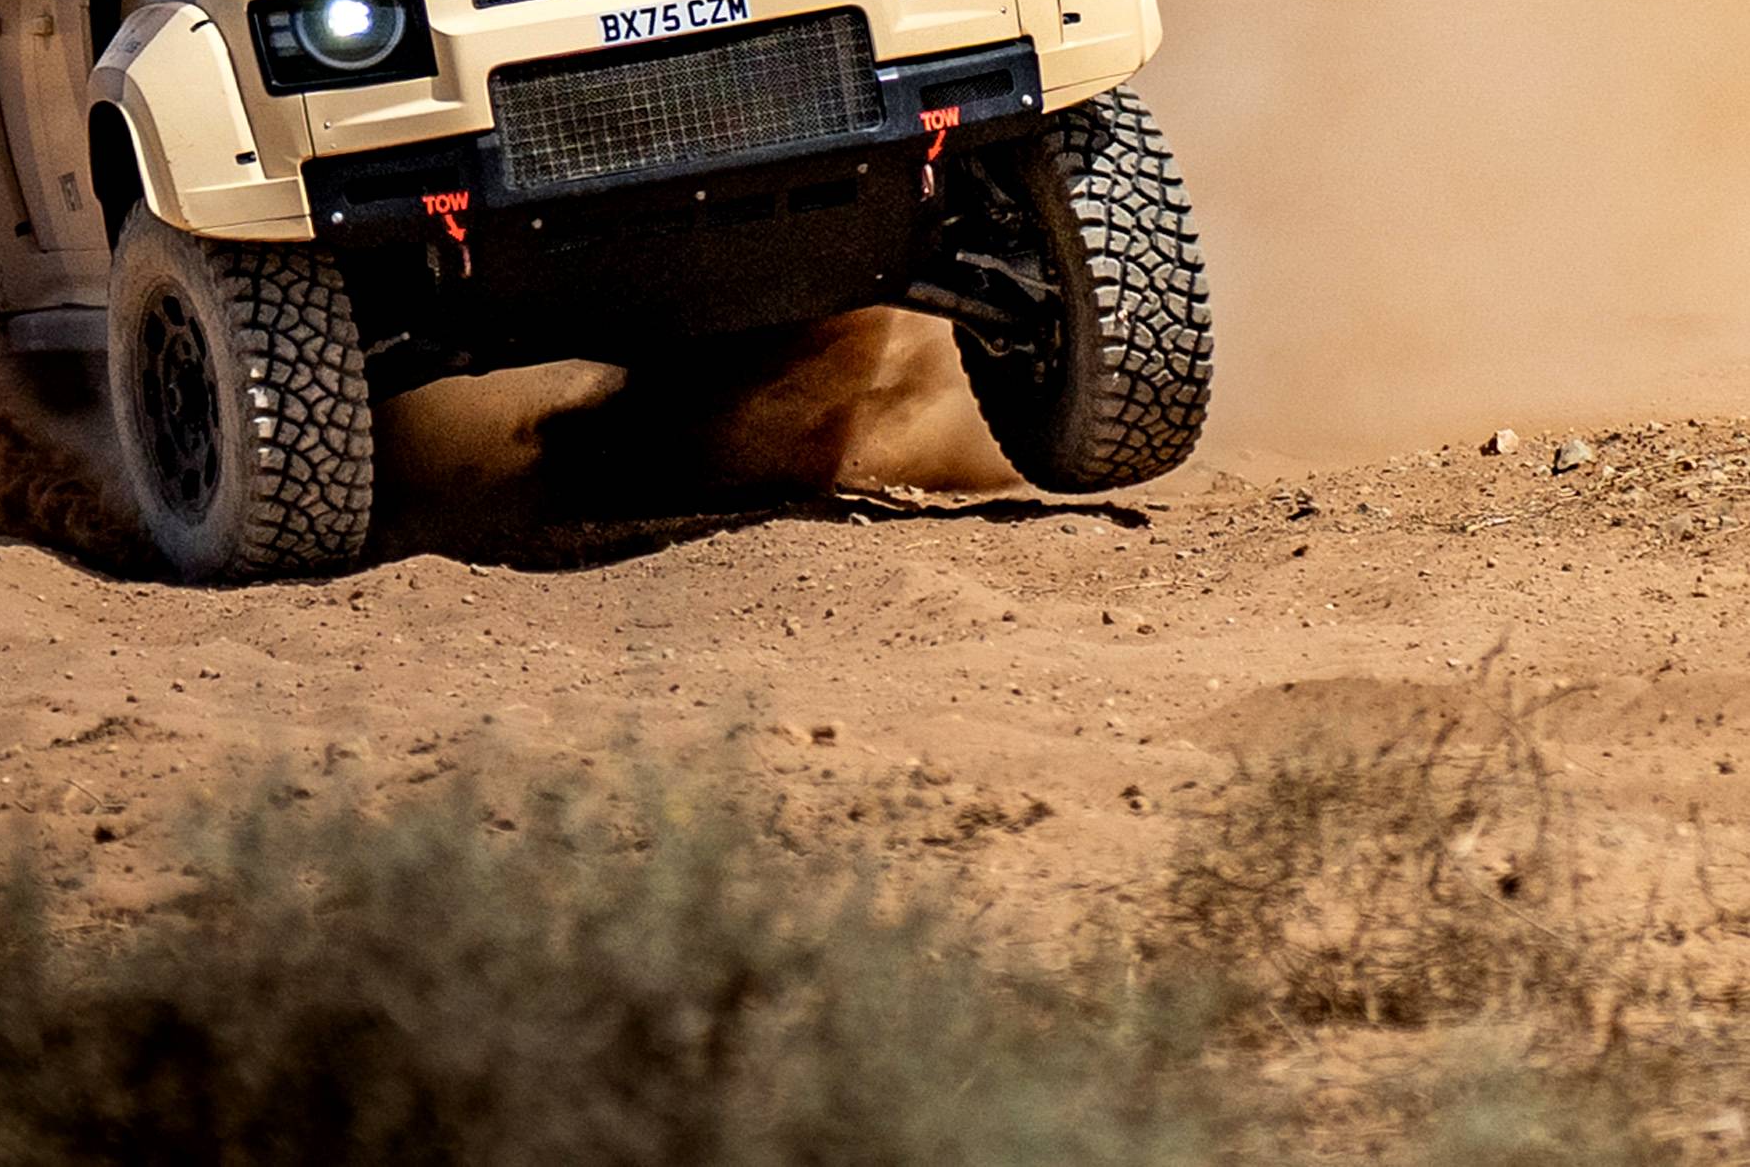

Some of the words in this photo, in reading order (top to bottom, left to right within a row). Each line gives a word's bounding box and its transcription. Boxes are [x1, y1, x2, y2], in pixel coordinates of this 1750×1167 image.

[600, 3, 682, 42] BX75
[919, 106, 959, 131] TOW
[422, 191, 468, 214] TOW
